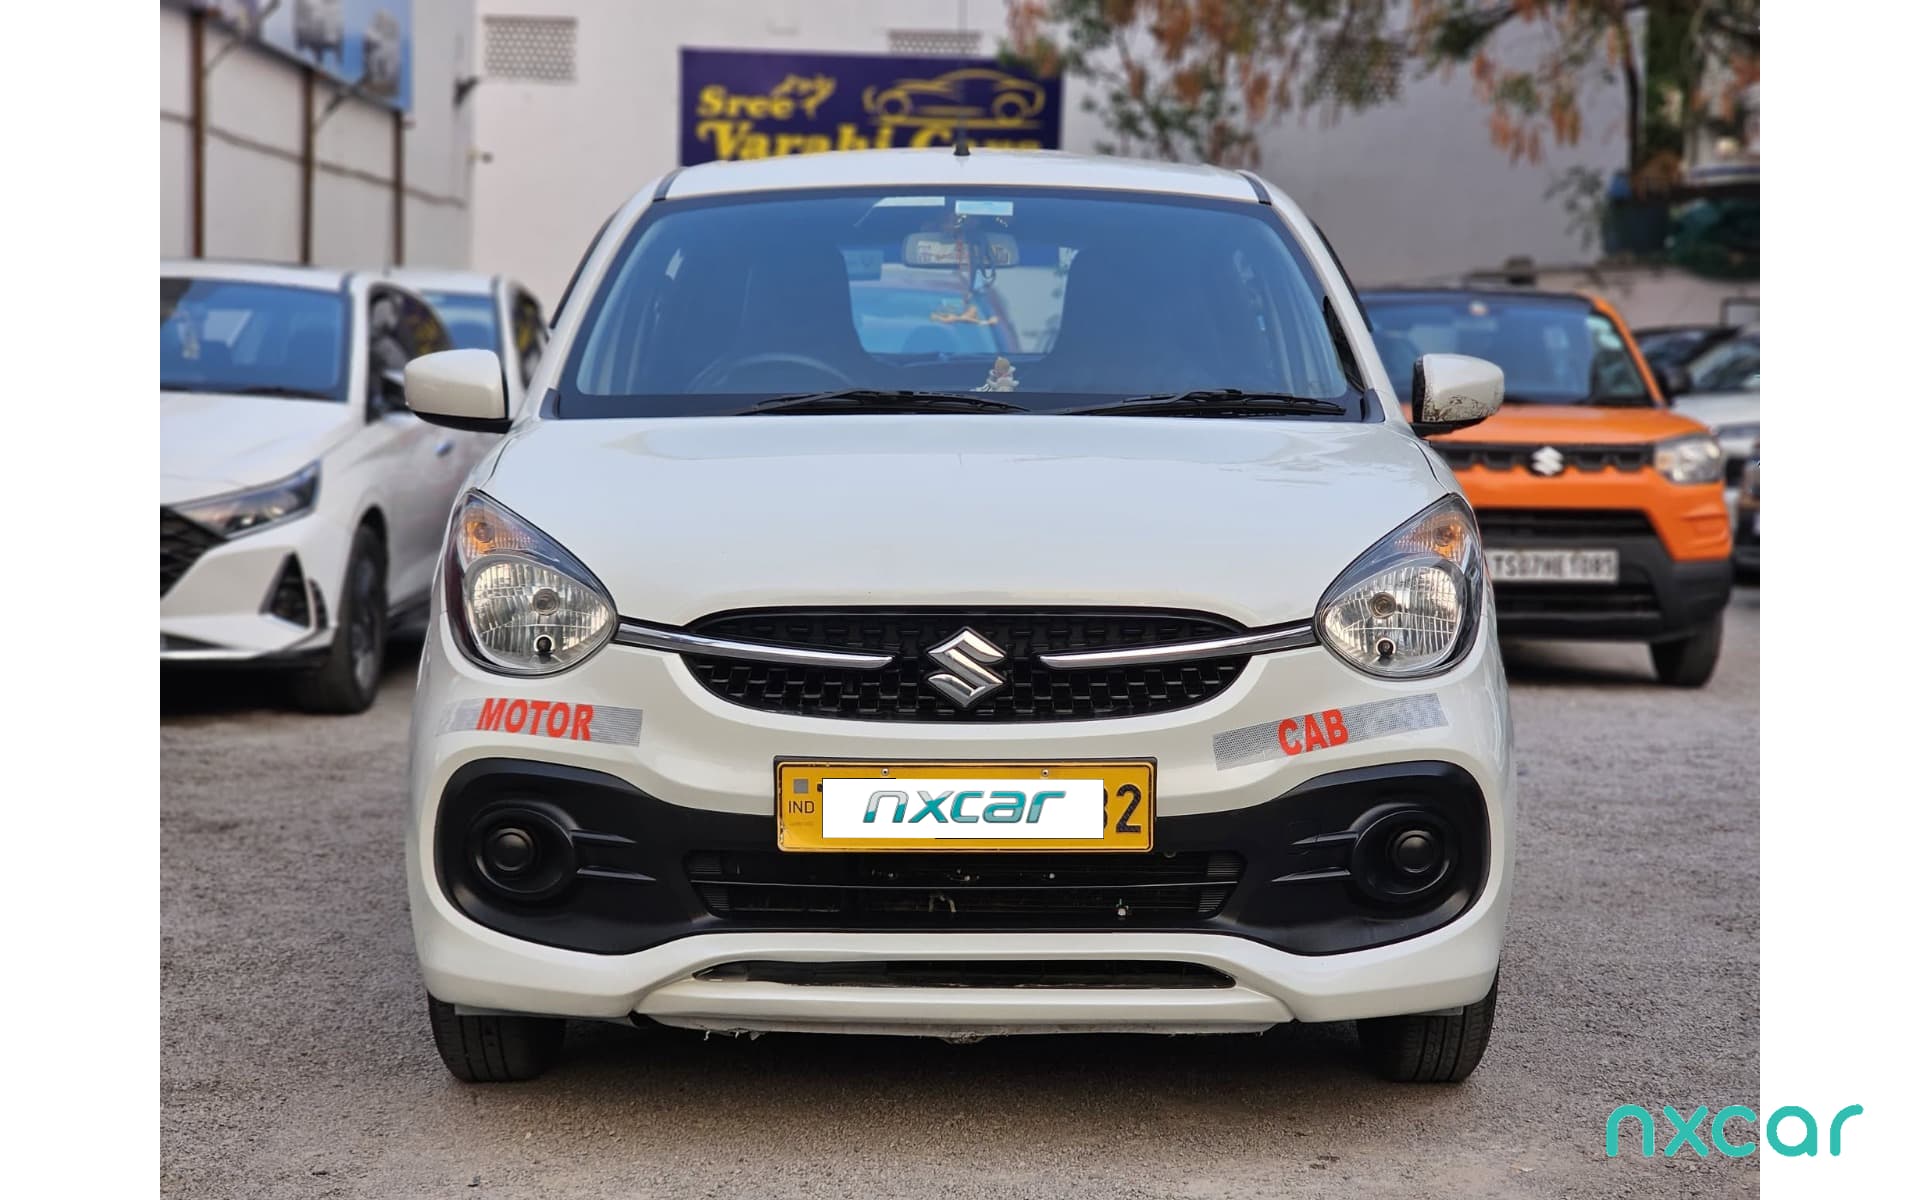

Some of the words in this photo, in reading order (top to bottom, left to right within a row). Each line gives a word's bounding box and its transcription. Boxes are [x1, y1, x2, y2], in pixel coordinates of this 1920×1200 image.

[697, 84, 794, 121] Sree
[476, 698, 594, 741] MOTOR
[1278, 708, 1348, 756] CAB
[788, 800, 815, 814] IND
